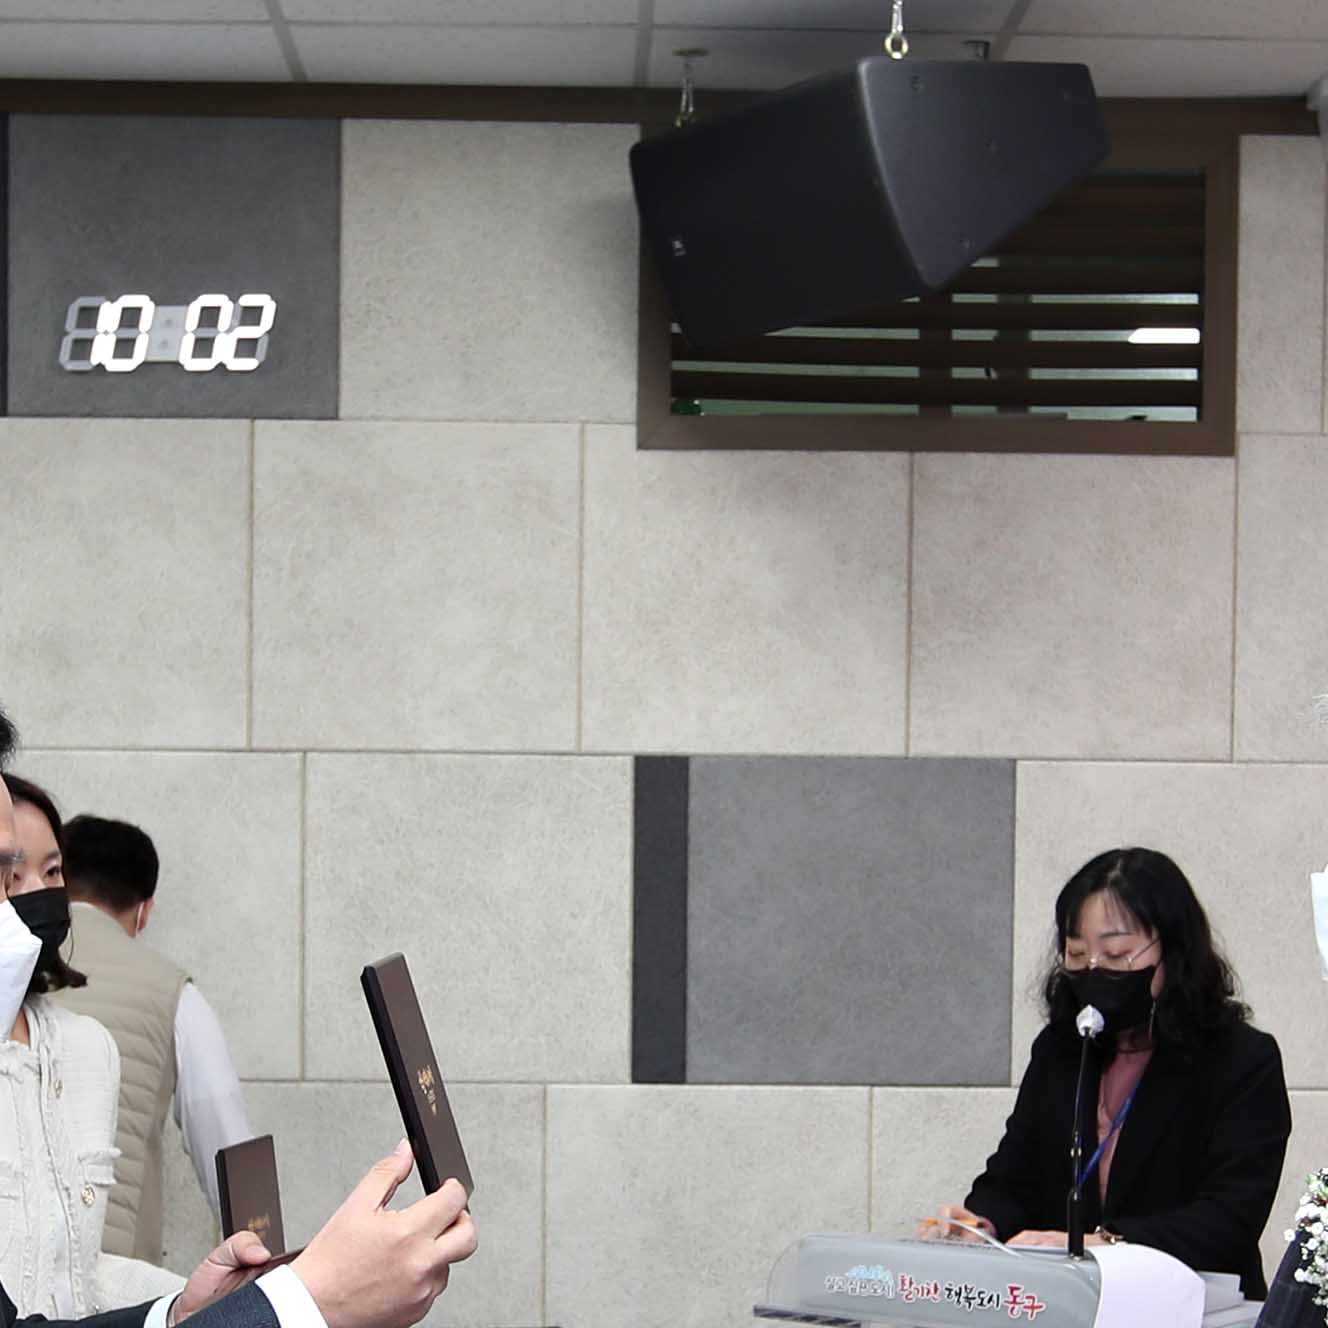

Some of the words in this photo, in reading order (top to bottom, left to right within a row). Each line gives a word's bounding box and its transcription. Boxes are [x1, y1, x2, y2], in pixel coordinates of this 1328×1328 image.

[899, 1274, 939, 1300] 활기찬
[945, 1283, 1000, 1309] 행복도시
[1005, 1285, 1044, 1317] 동구
